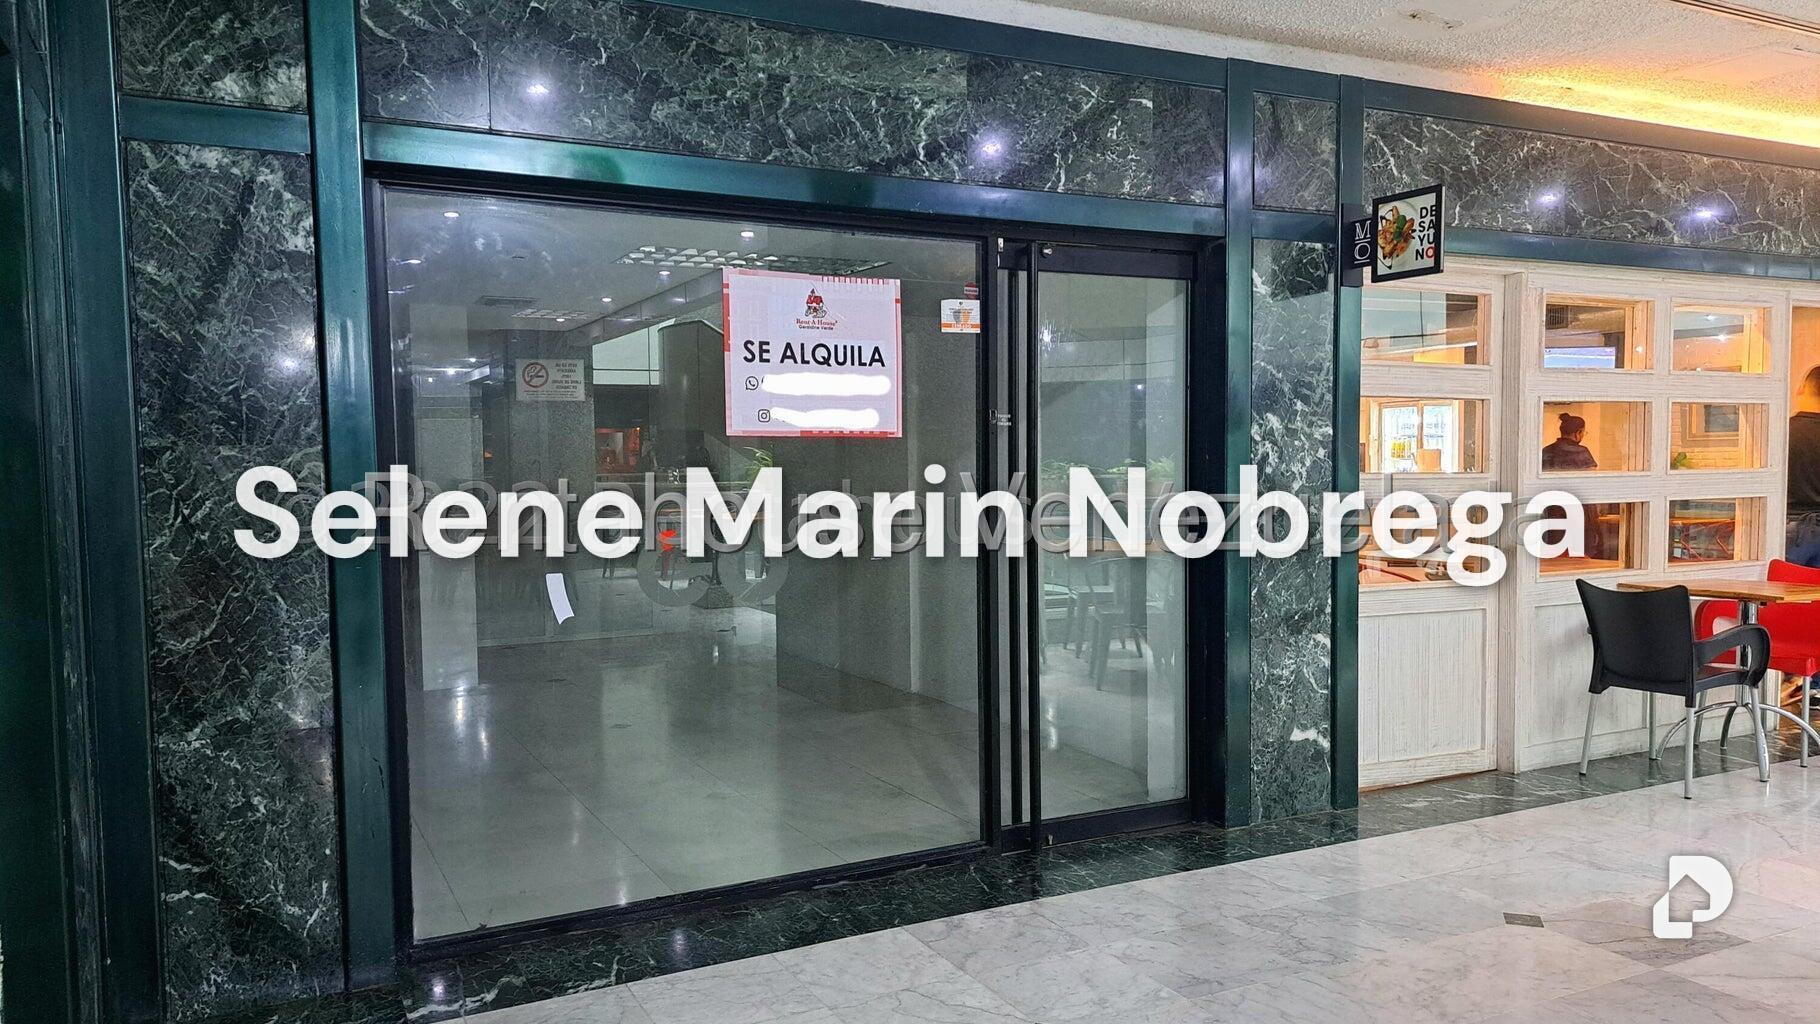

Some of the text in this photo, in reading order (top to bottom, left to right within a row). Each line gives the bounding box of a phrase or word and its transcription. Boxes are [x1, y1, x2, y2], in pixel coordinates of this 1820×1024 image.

[1418, 218, 1436, 232] SA
[1417, 231, 1436, 246] YU
[1415, 246, 1436, 261] NO
[743, 339, 886, 367] SE ALQUILA
